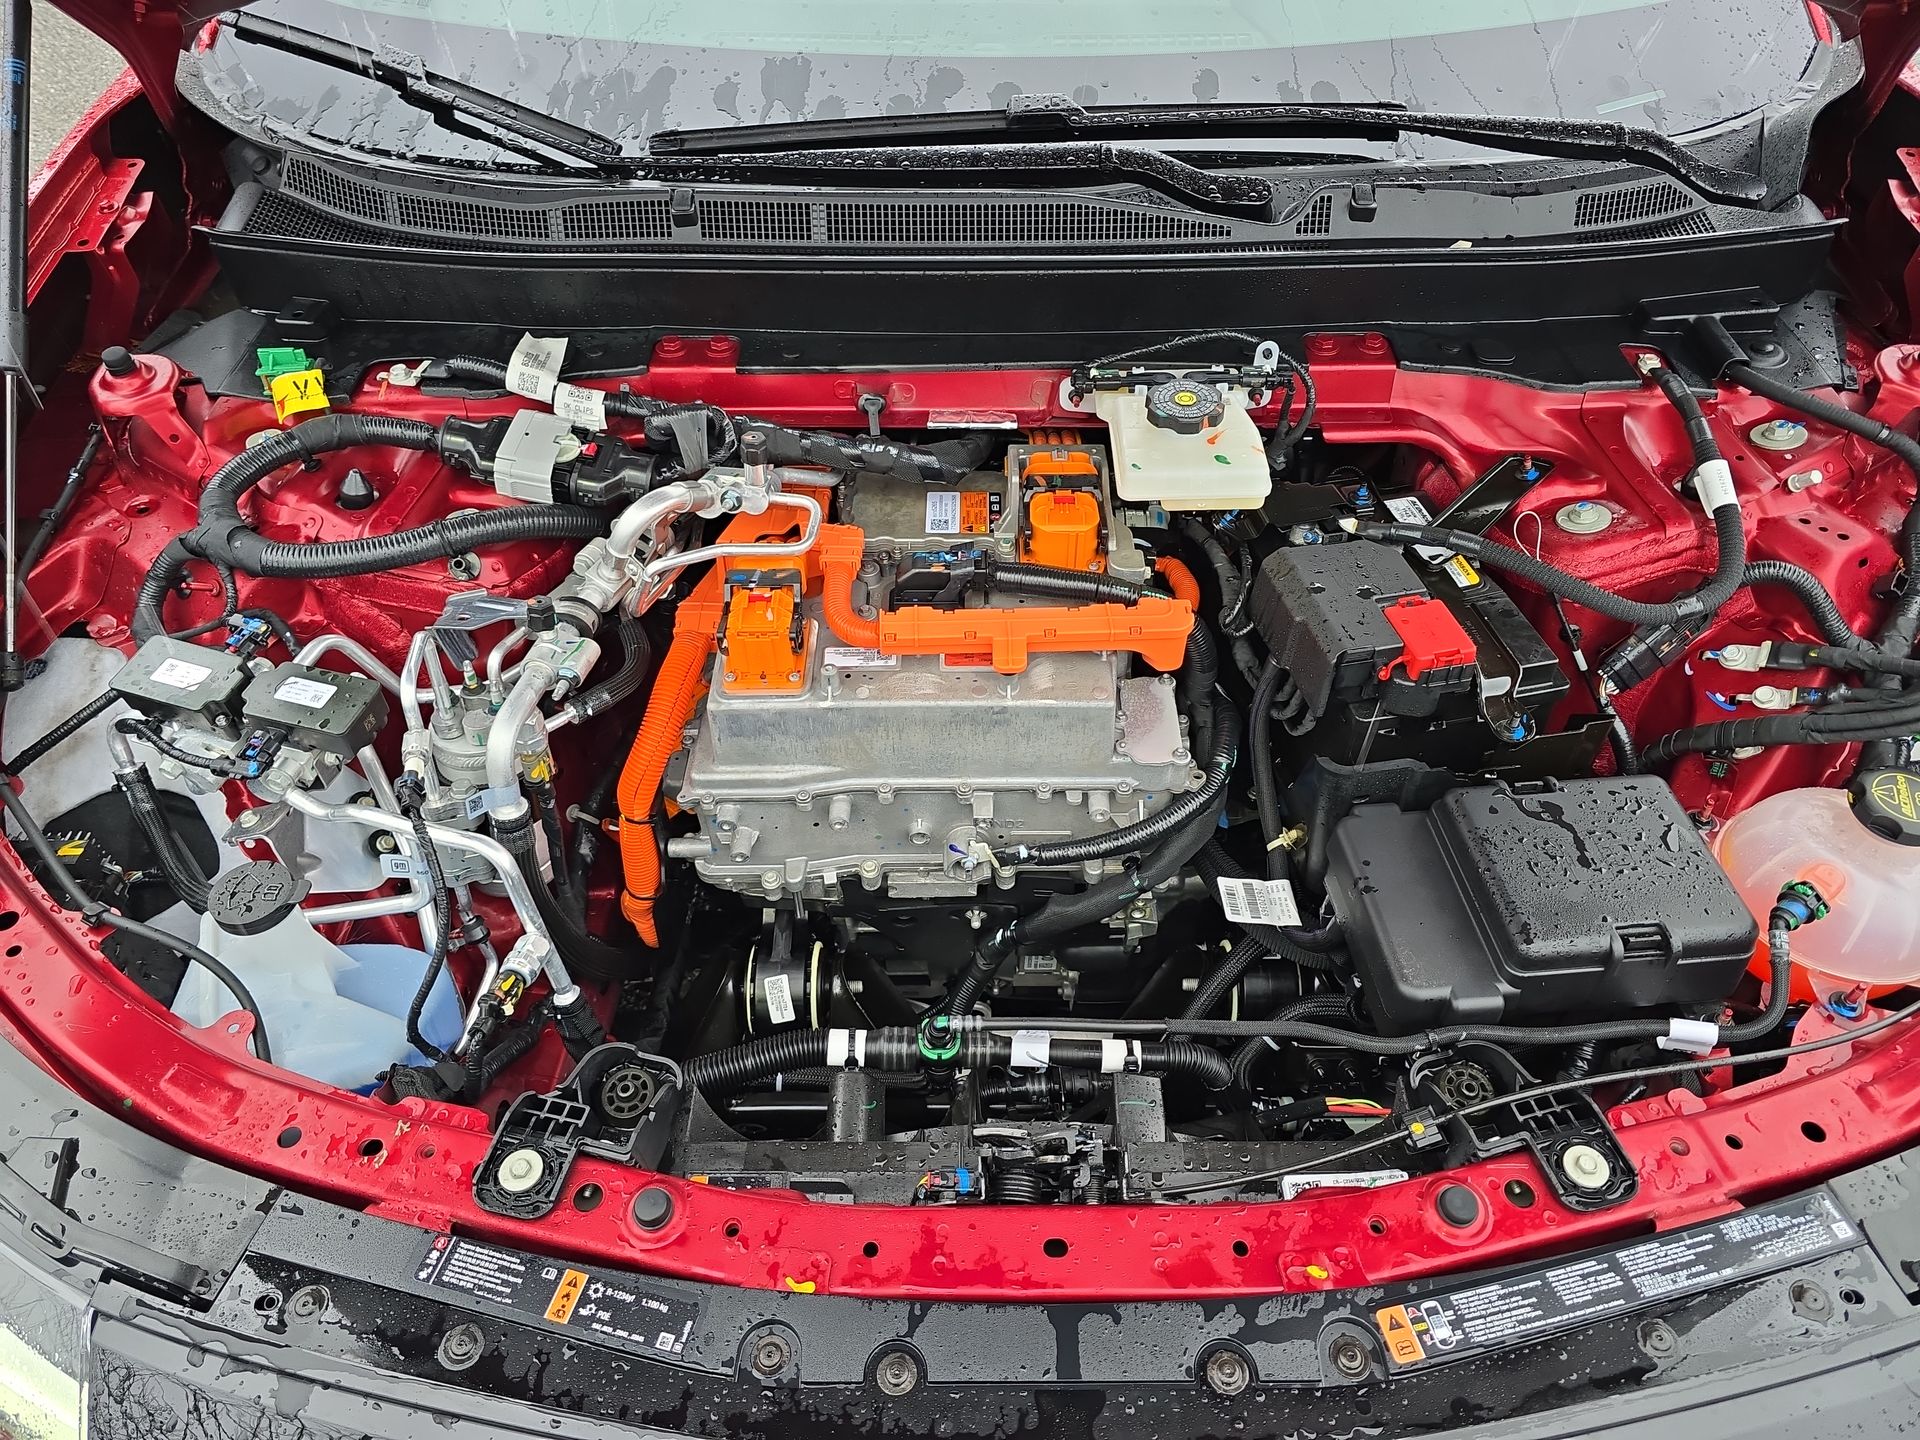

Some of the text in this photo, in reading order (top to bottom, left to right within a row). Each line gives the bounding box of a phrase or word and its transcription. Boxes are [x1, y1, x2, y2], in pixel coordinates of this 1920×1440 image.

[1456, 558, 1471, 576] POISON
[1896, 774, 1912, 817] ACDelco
[393, 861, 406, 870] gm
[605, 1287, 669, 1313] R-1234yf 1.100 kg
[595, 1309, 611, 1321] POE
